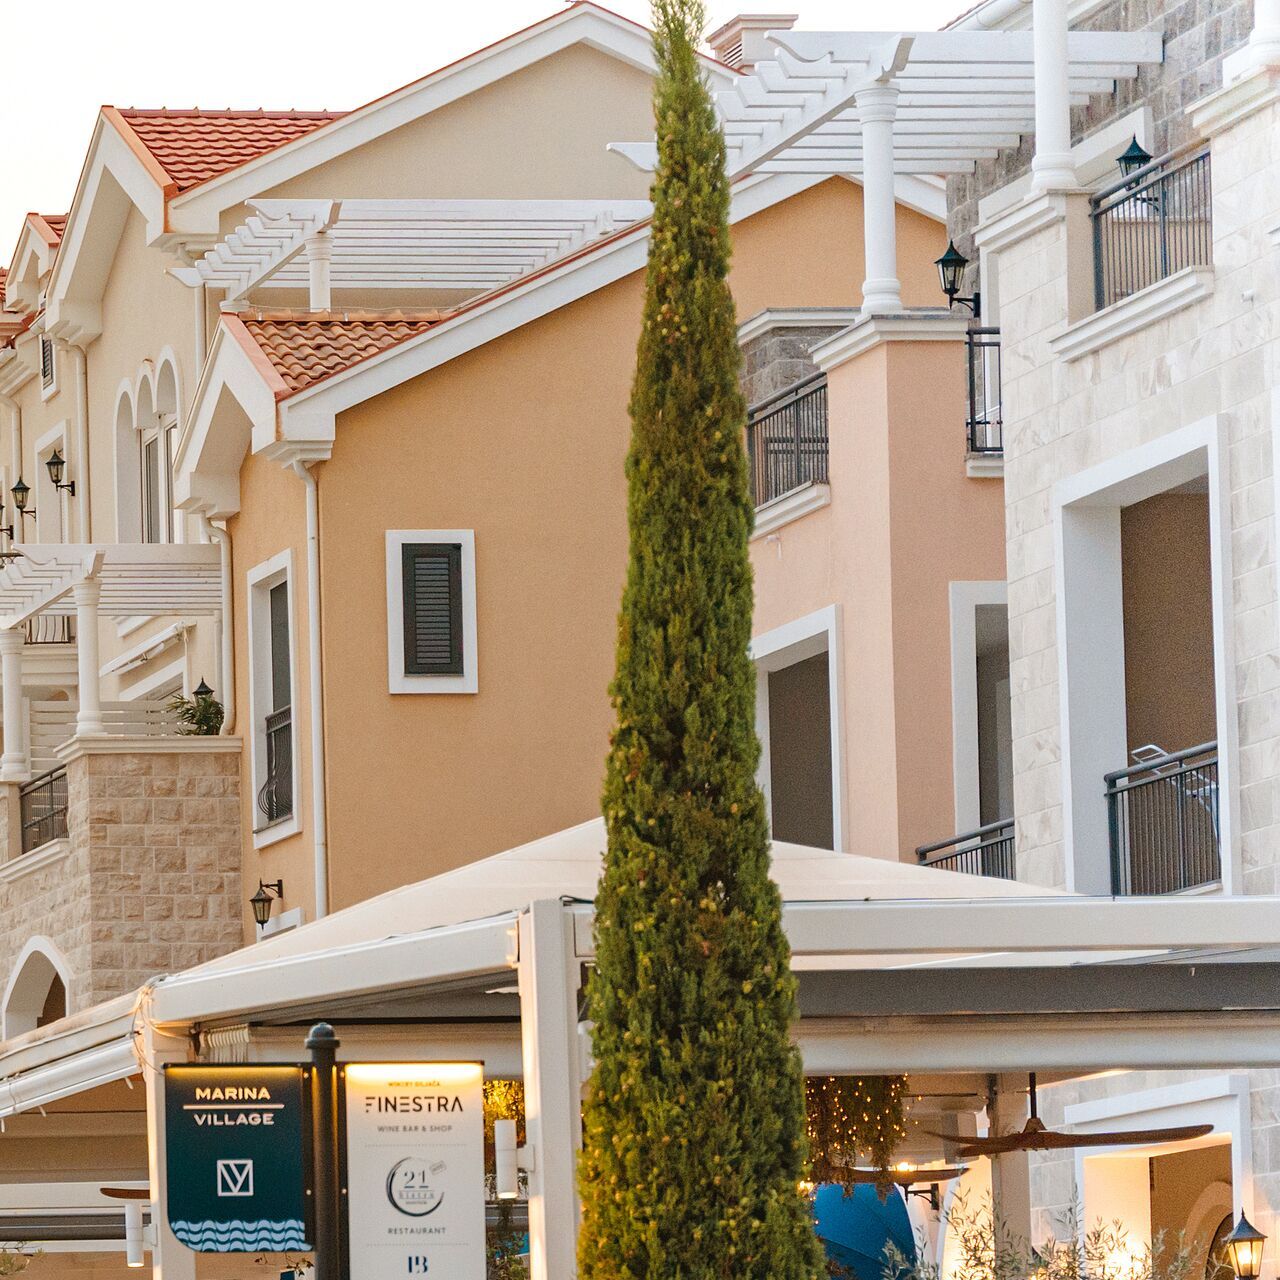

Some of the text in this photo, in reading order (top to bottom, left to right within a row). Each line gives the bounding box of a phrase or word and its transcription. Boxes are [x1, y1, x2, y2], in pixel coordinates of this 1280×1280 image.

[195, 1087, 271, 1100] MARINA
[365, 1096, 463, 1113] FINESTRA
[193, 1113, 275, 1126] VILLAGE
[404, 1170, 429, 1189] 21
[387, 1227, 447, 1235] RESTAURANT
